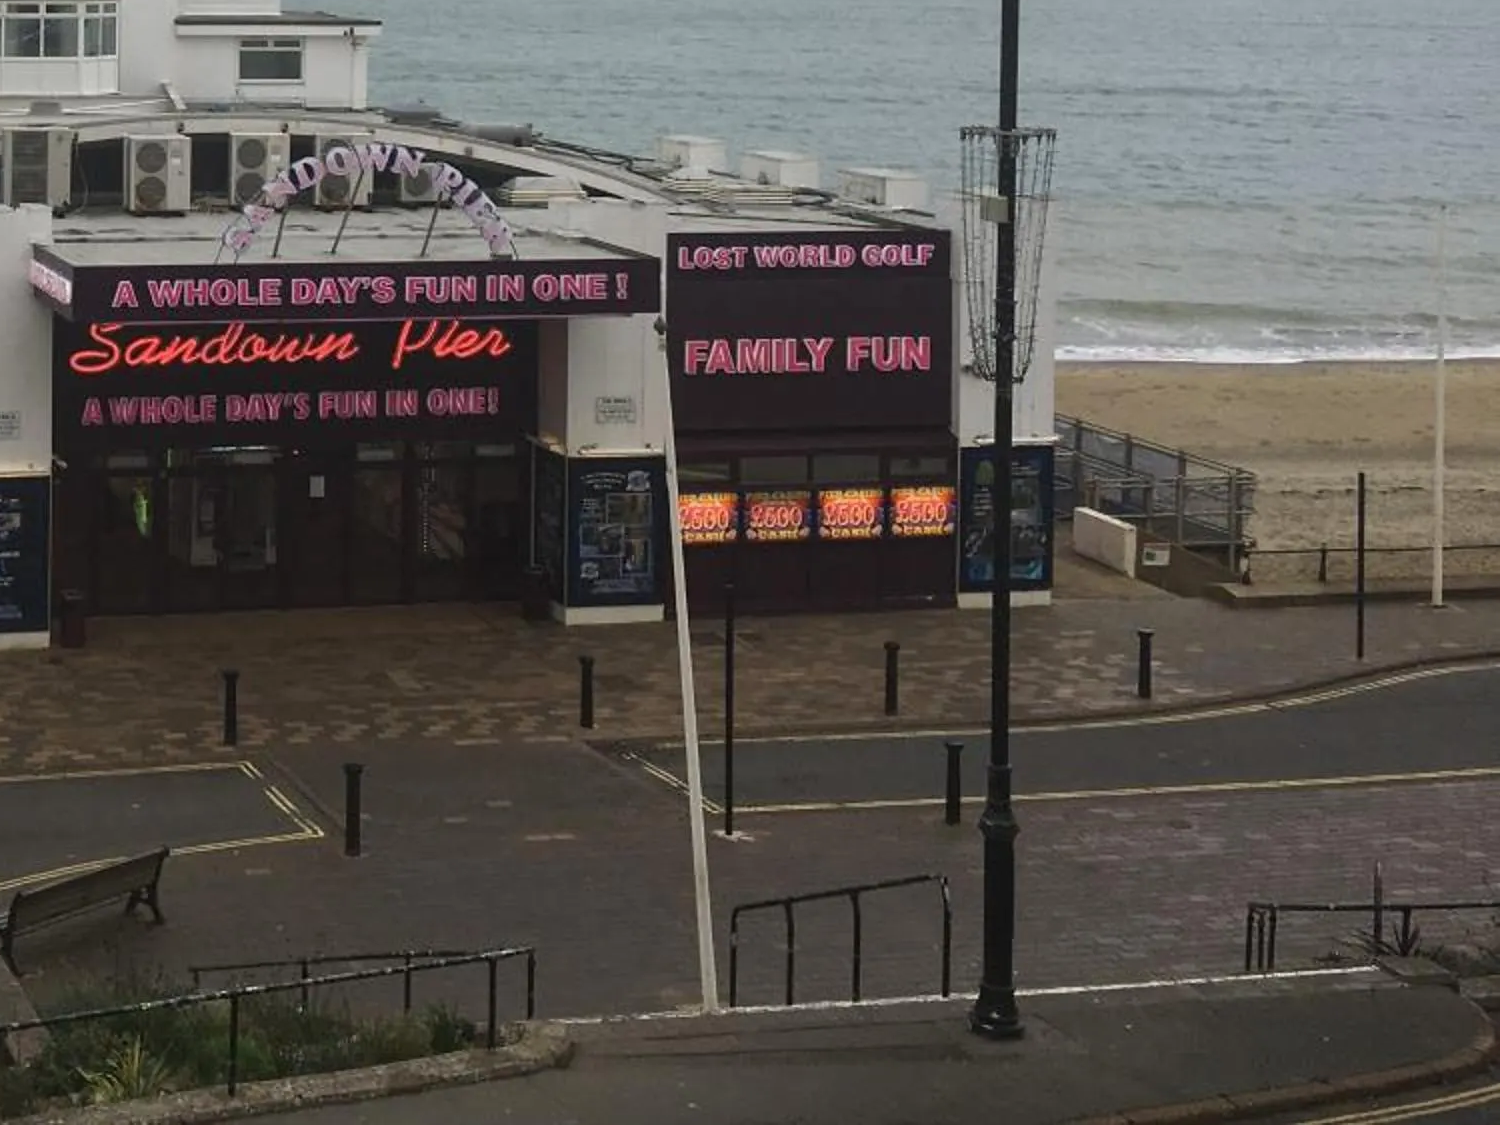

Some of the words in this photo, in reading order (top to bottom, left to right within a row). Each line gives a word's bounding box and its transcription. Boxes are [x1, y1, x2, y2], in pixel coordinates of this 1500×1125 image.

[678, 246, 748, 270] LOST
[753, 245, 856, 269] WORLD
[861, 244, 934, 267] GOLF
[112, 280, 138, 308] A
[148, 278, 283, 308] WHOLE
[291, 276, 396, 305] DAY'S
[404, 275, 476, 304] FUN
[485, 275, 525, 302] IN
[532, 273, 608, 301] ONE
[68, 319, 360, 374] Sandown
[391, 316, 512, 370] Pier
[684, 338, 834, 375] FAMILY
[846, 336, 932, 373] FUN
[81, 397, 104, 424] A
[107, 394, 218, 424] WHOLE
[225, 392, 310, 422] DAY'S
[319, 390, 377, 419] FUN
[385, 389, 418, 416] IN
[823, 503, 875, 526] £500
[895, 500, 947, 524] £500
